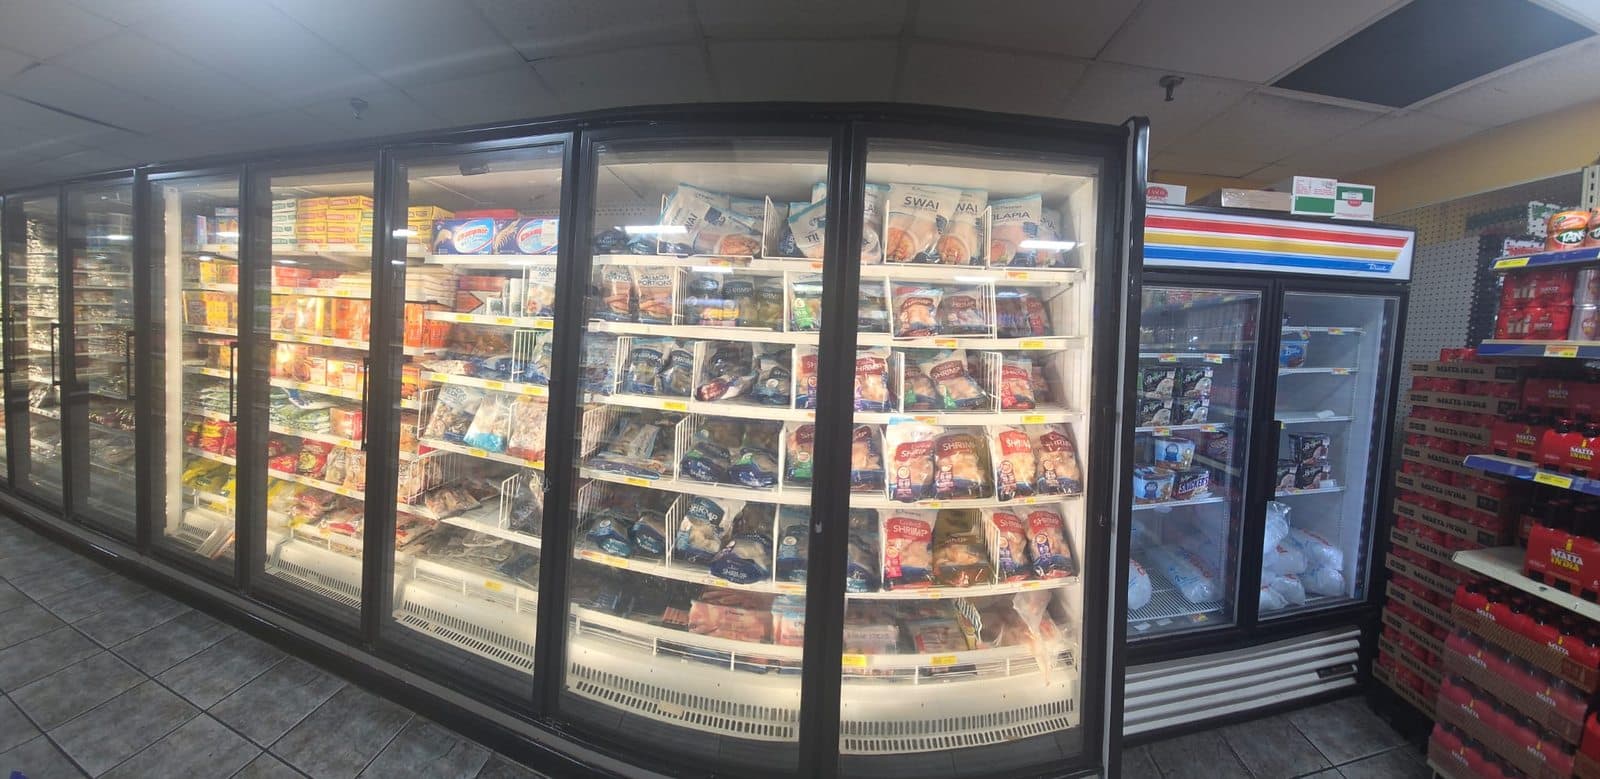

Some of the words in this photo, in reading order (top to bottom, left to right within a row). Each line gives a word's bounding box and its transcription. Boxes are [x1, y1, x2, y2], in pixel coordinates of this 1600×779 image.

[903, 195, 940, 210] SWAI
[955, 202, 979, 213] WAI
[992, 210, 1031, 221] ILAPIA
[1569, 446, 1595, 457] MALTA
[1569, 452, 1592, 461] INDIA
[892, 524, 929, 537] SHRIMP
[1551, 548, 1584, 566] MALTA
[1551, 556, 1580, 572] INDIA
[1548, 641, 1569, 656] MALTA
